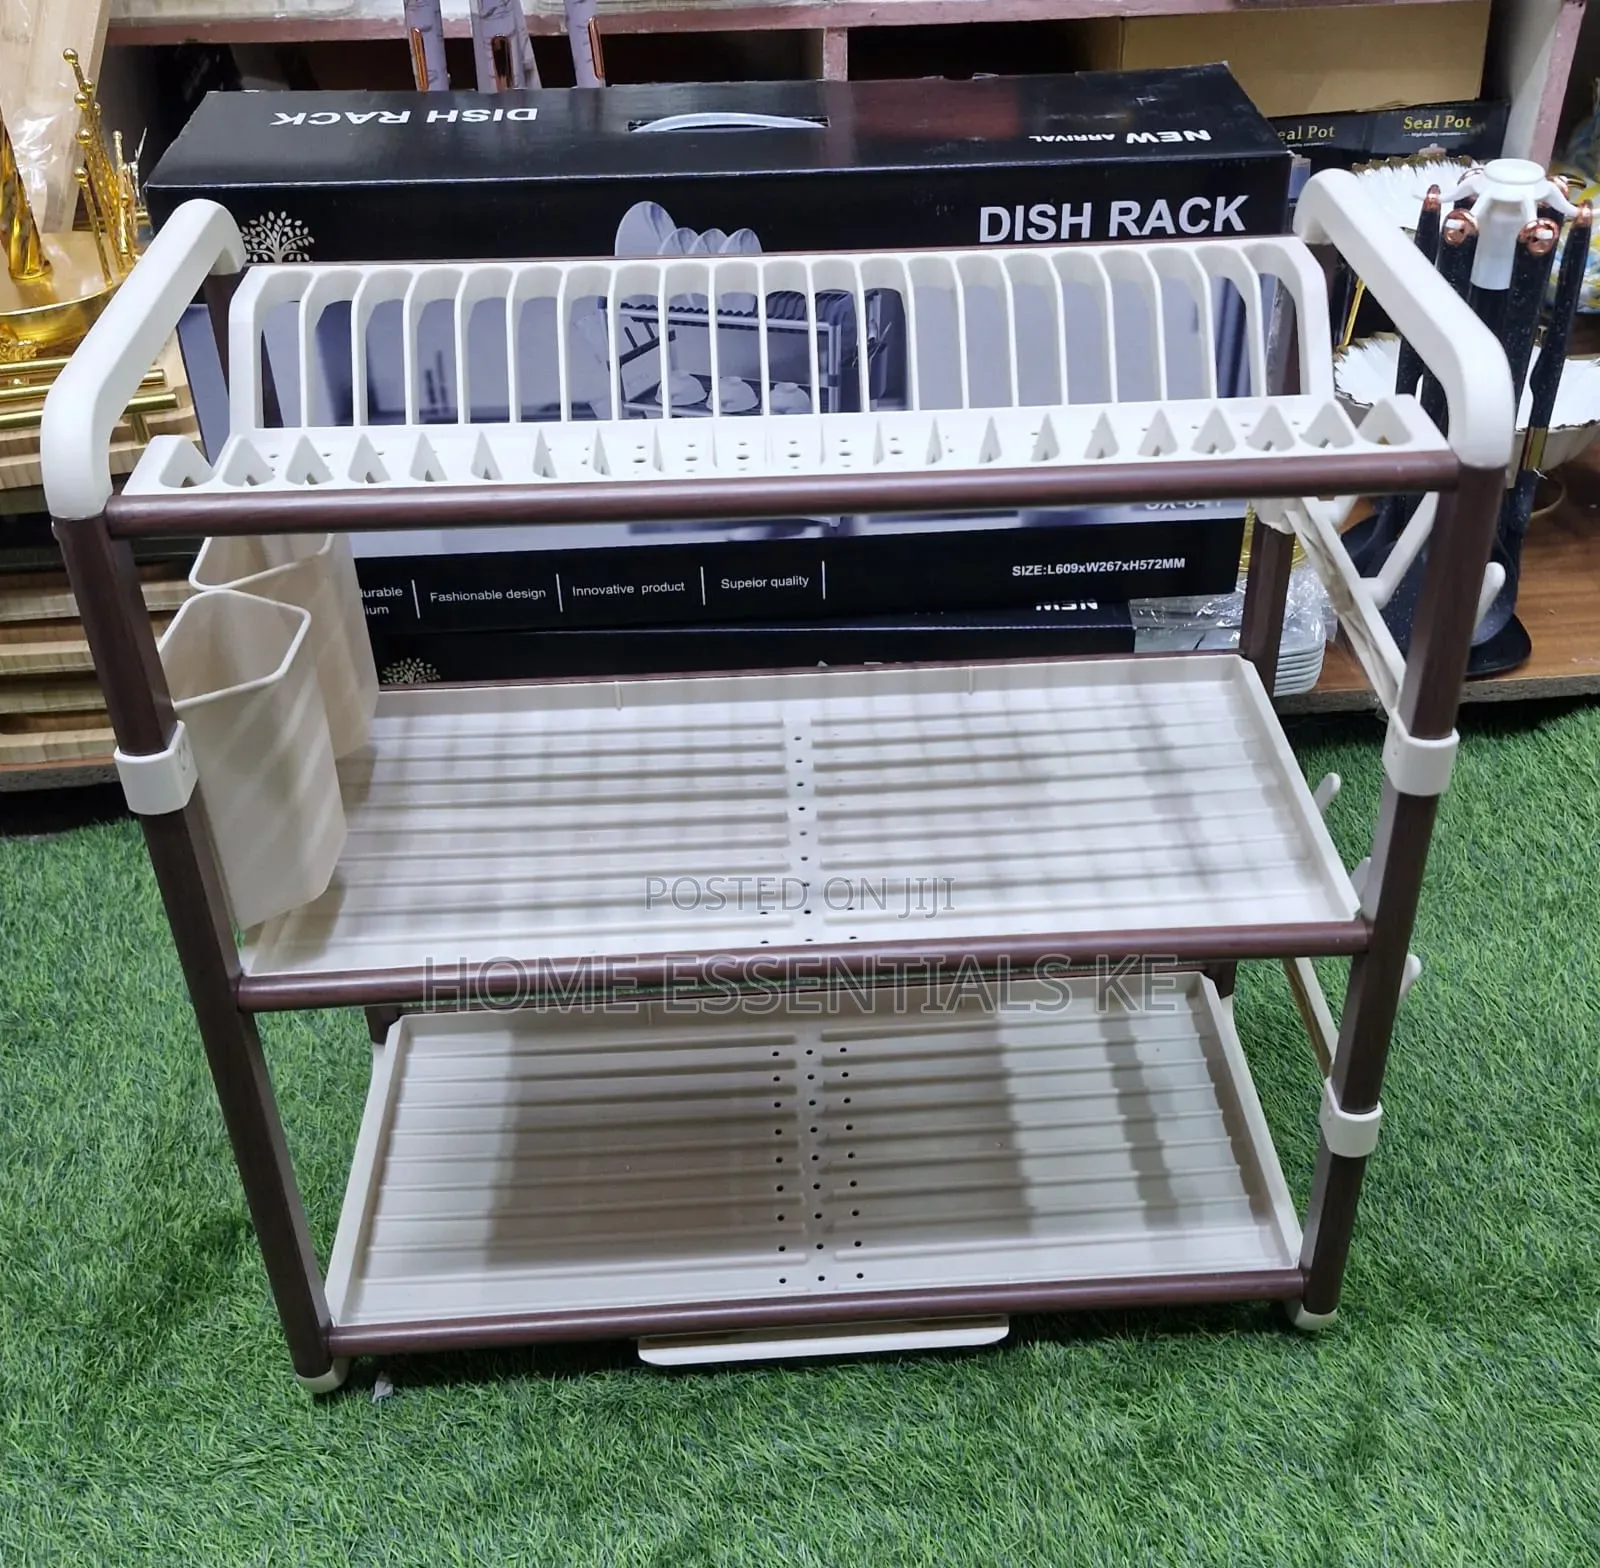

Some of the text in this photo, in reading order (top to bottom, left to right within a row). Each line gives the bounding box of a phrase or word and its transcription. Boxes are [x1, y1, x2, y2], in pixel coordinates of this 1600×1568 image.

[269, 107, 538, 126] DISH RACK
[1403, 114, 1472, 130] Seal Pot
[1028, 130, 1212, 144] NEW ARRIVAL
[1277, 125, 1335, 141] eal Pot
[979, 194, 1249, 243] DISH RACK
[1012, 558, 1186, 577] SIZE:L609xW267xH572MM
[572, 582, 685, 597] Innovative product
[720, 575, 810, 592] Supeior quality
[430, 588, 546, 603] Fashionable design
